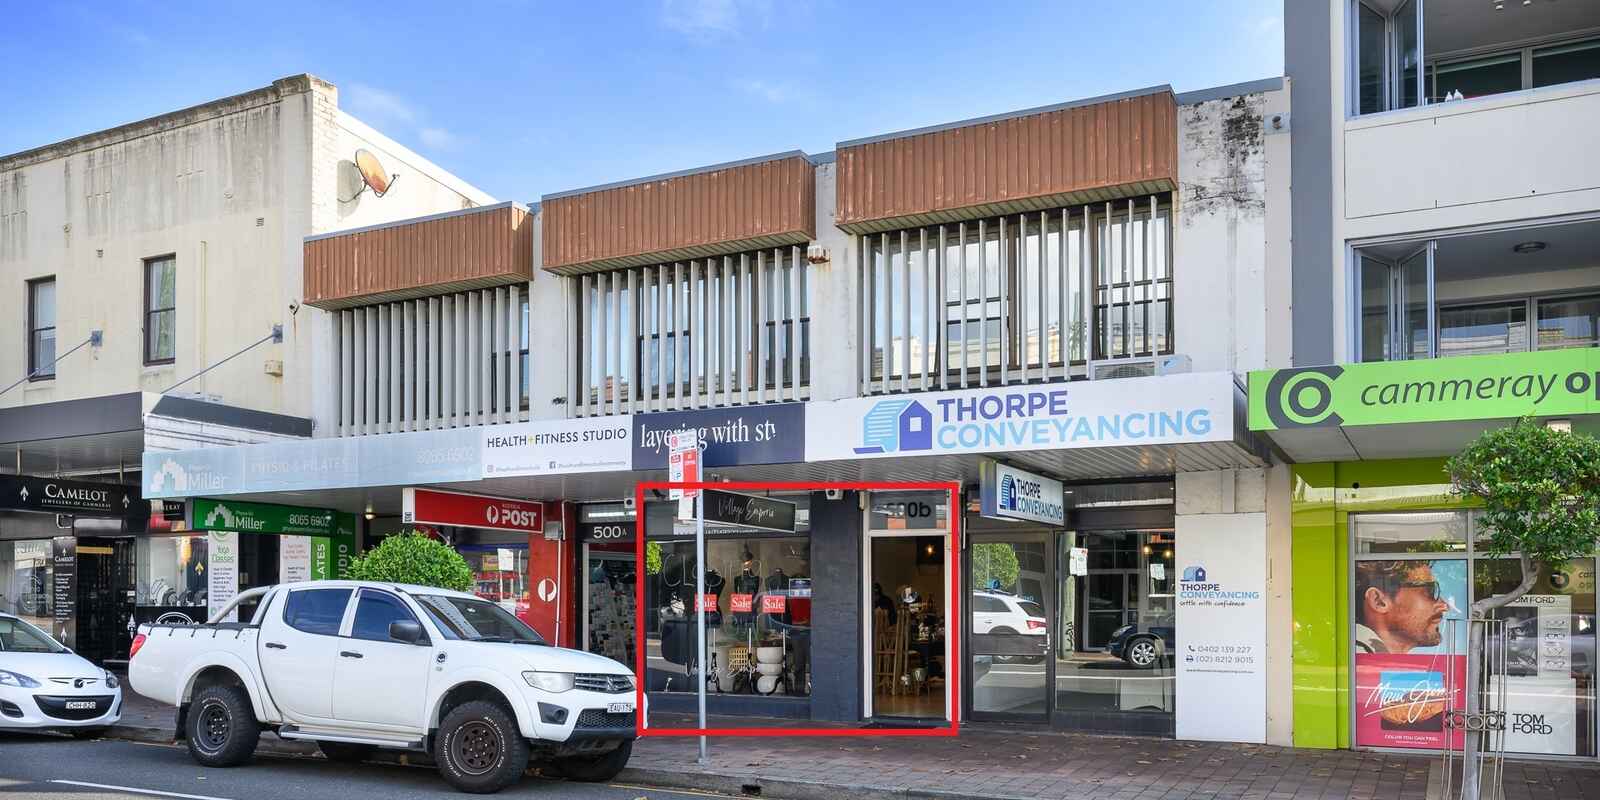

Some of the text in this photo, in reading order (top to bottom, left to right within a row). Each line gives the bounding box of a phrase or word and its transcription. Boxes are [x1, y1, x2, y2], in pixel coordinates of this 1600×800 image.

[1361, 371, 1600, 405] cammeray o
[937, 390, 1068, 422] THORPE
[583, 428, 626, 441] STUDIO
[641, 423, 706, 454] layeg
[712, 417, 750, 443] with
[937, 409, 1212, 449] CONVEYANCING
[188, 472, 226, 489] Miller
[45, 484, 108, 502] CAMELOT
[1017, 479, 1041, 499] THORPE
[1017, 497, 1063, 520] CONVEYANCING
[233, 513, 330, 530] Miller 8065 6902
[501, 510, 536, 527] POST
[1180, 583, 1220, 592] THORPE
[1180, 591, 1260, 599] CONVEYANCING
[731, 597, 752, 609] Sale
[763, 599, 785, 611] Sale
[1530, 596, 1555, 604] FORD
[1236, 646, 1252, 654] 227
[1196, 655, 1214, 664] (02)
[1513, 714, 1545, 724] TOM
[1513, 723, 1553, 735] FORD
